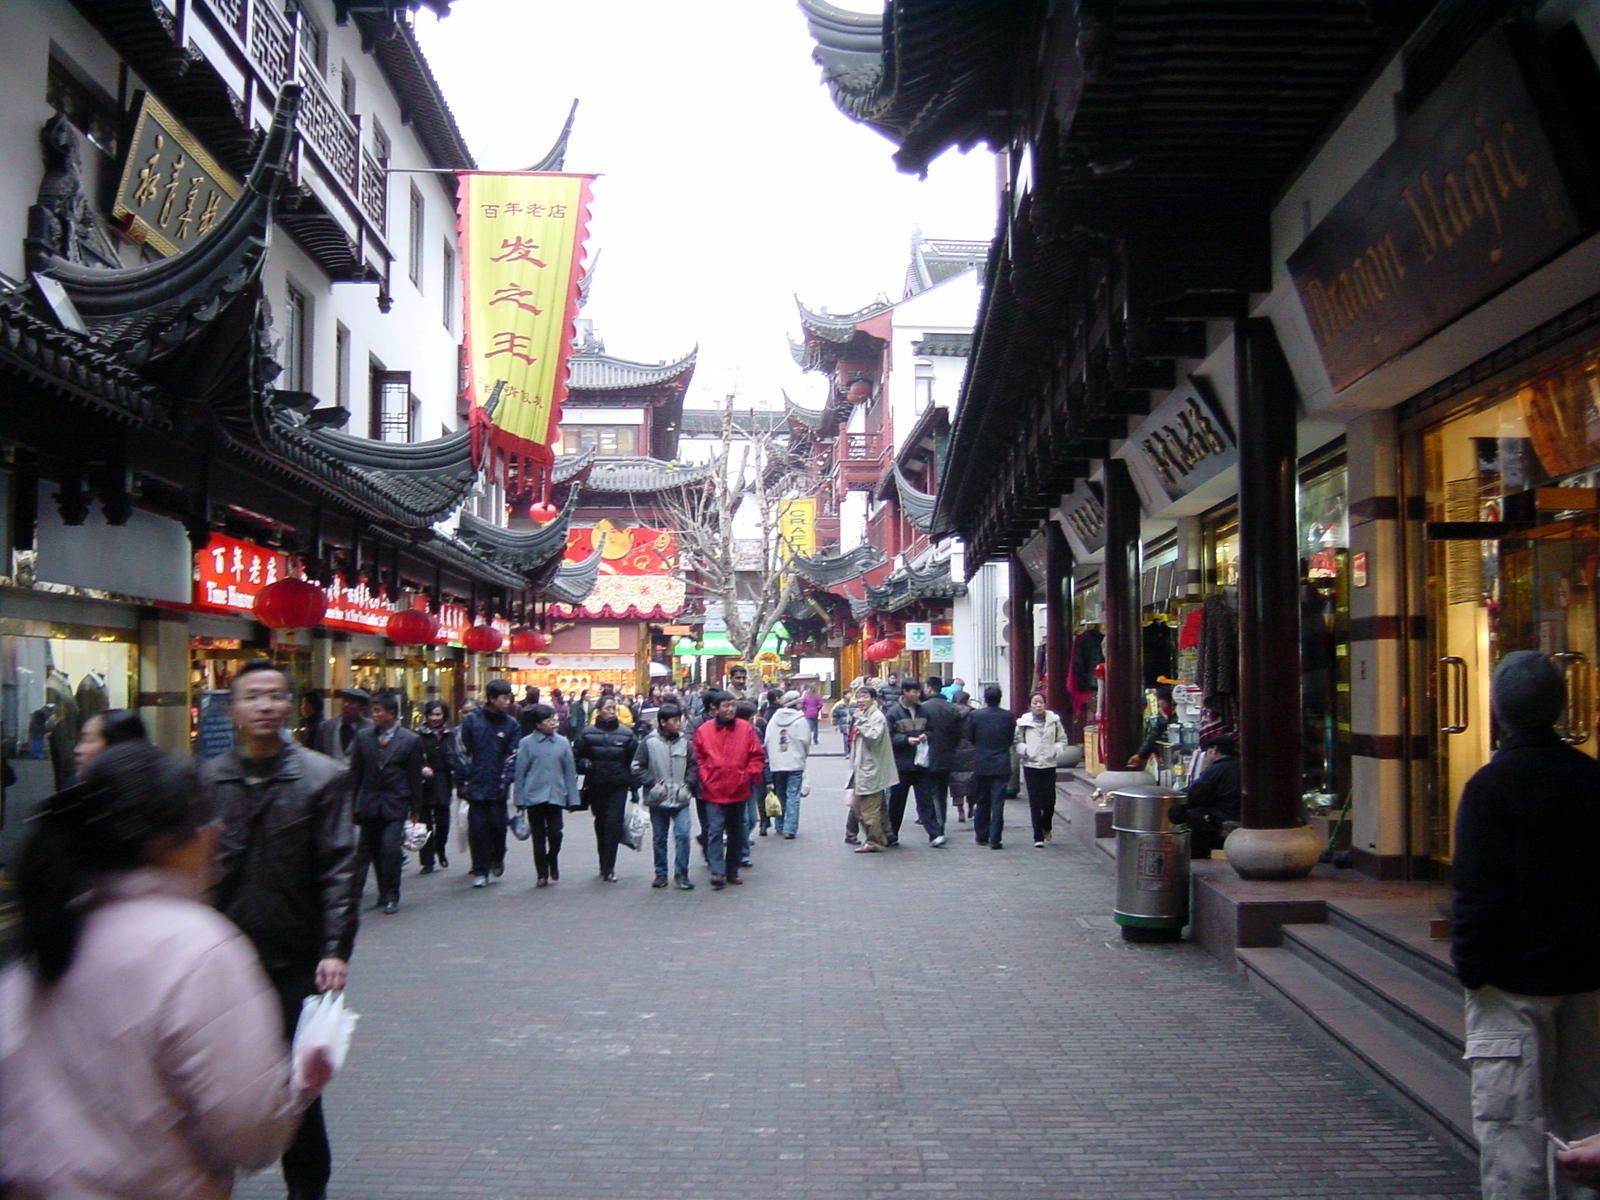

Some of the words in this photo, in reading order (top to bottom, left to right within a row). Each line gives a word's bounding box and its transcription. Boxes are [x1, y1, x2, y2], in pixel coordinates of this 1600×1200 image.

[480, 202, 568, 219] 百年老店
[1305, 230, 1406, 345] Dragon
[1402, 112, 1531, 265] Magic
[484, 235, 548, 366] 发之王
[211, 545, 277, 586] 百年老店
